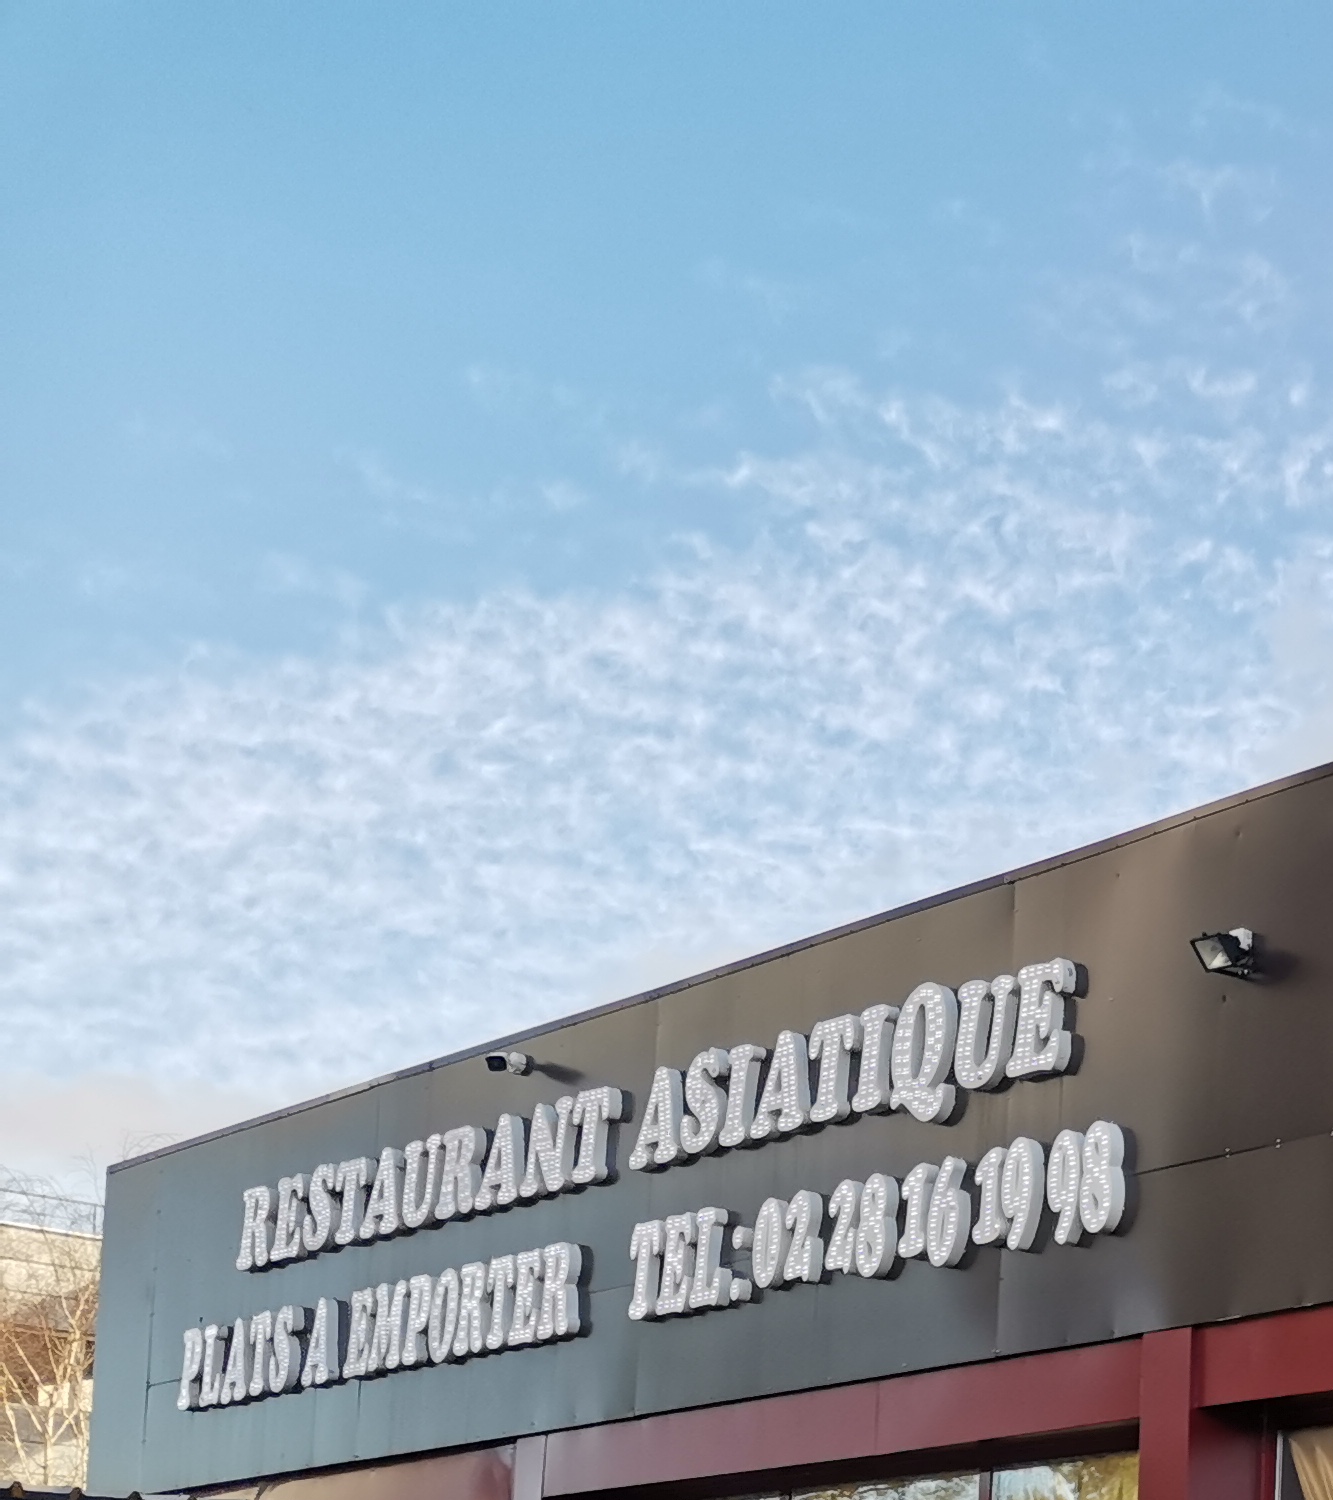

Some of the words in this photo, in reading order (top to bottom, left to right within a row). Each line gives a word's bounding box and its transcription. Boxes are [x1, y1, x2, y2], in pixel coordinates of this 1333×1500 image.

[236, 1085, 624, 1272] RESTAURANT
[629, 957, 1077, 1171] ASIATIQUE
[752, 1189, 824, 1289] 02
[825, 1172, 900, 1278] 28
[899, 1156, 972, 1268] 16
[972, 1136, 1045, 1251] 19
[1047, 1120, 1126, 1246] 98
[177, 1304, 305, 1412] PLATS
[301, 1297, 339, 1388] A
[342, 1242, 582, 1379] EMPORTER
